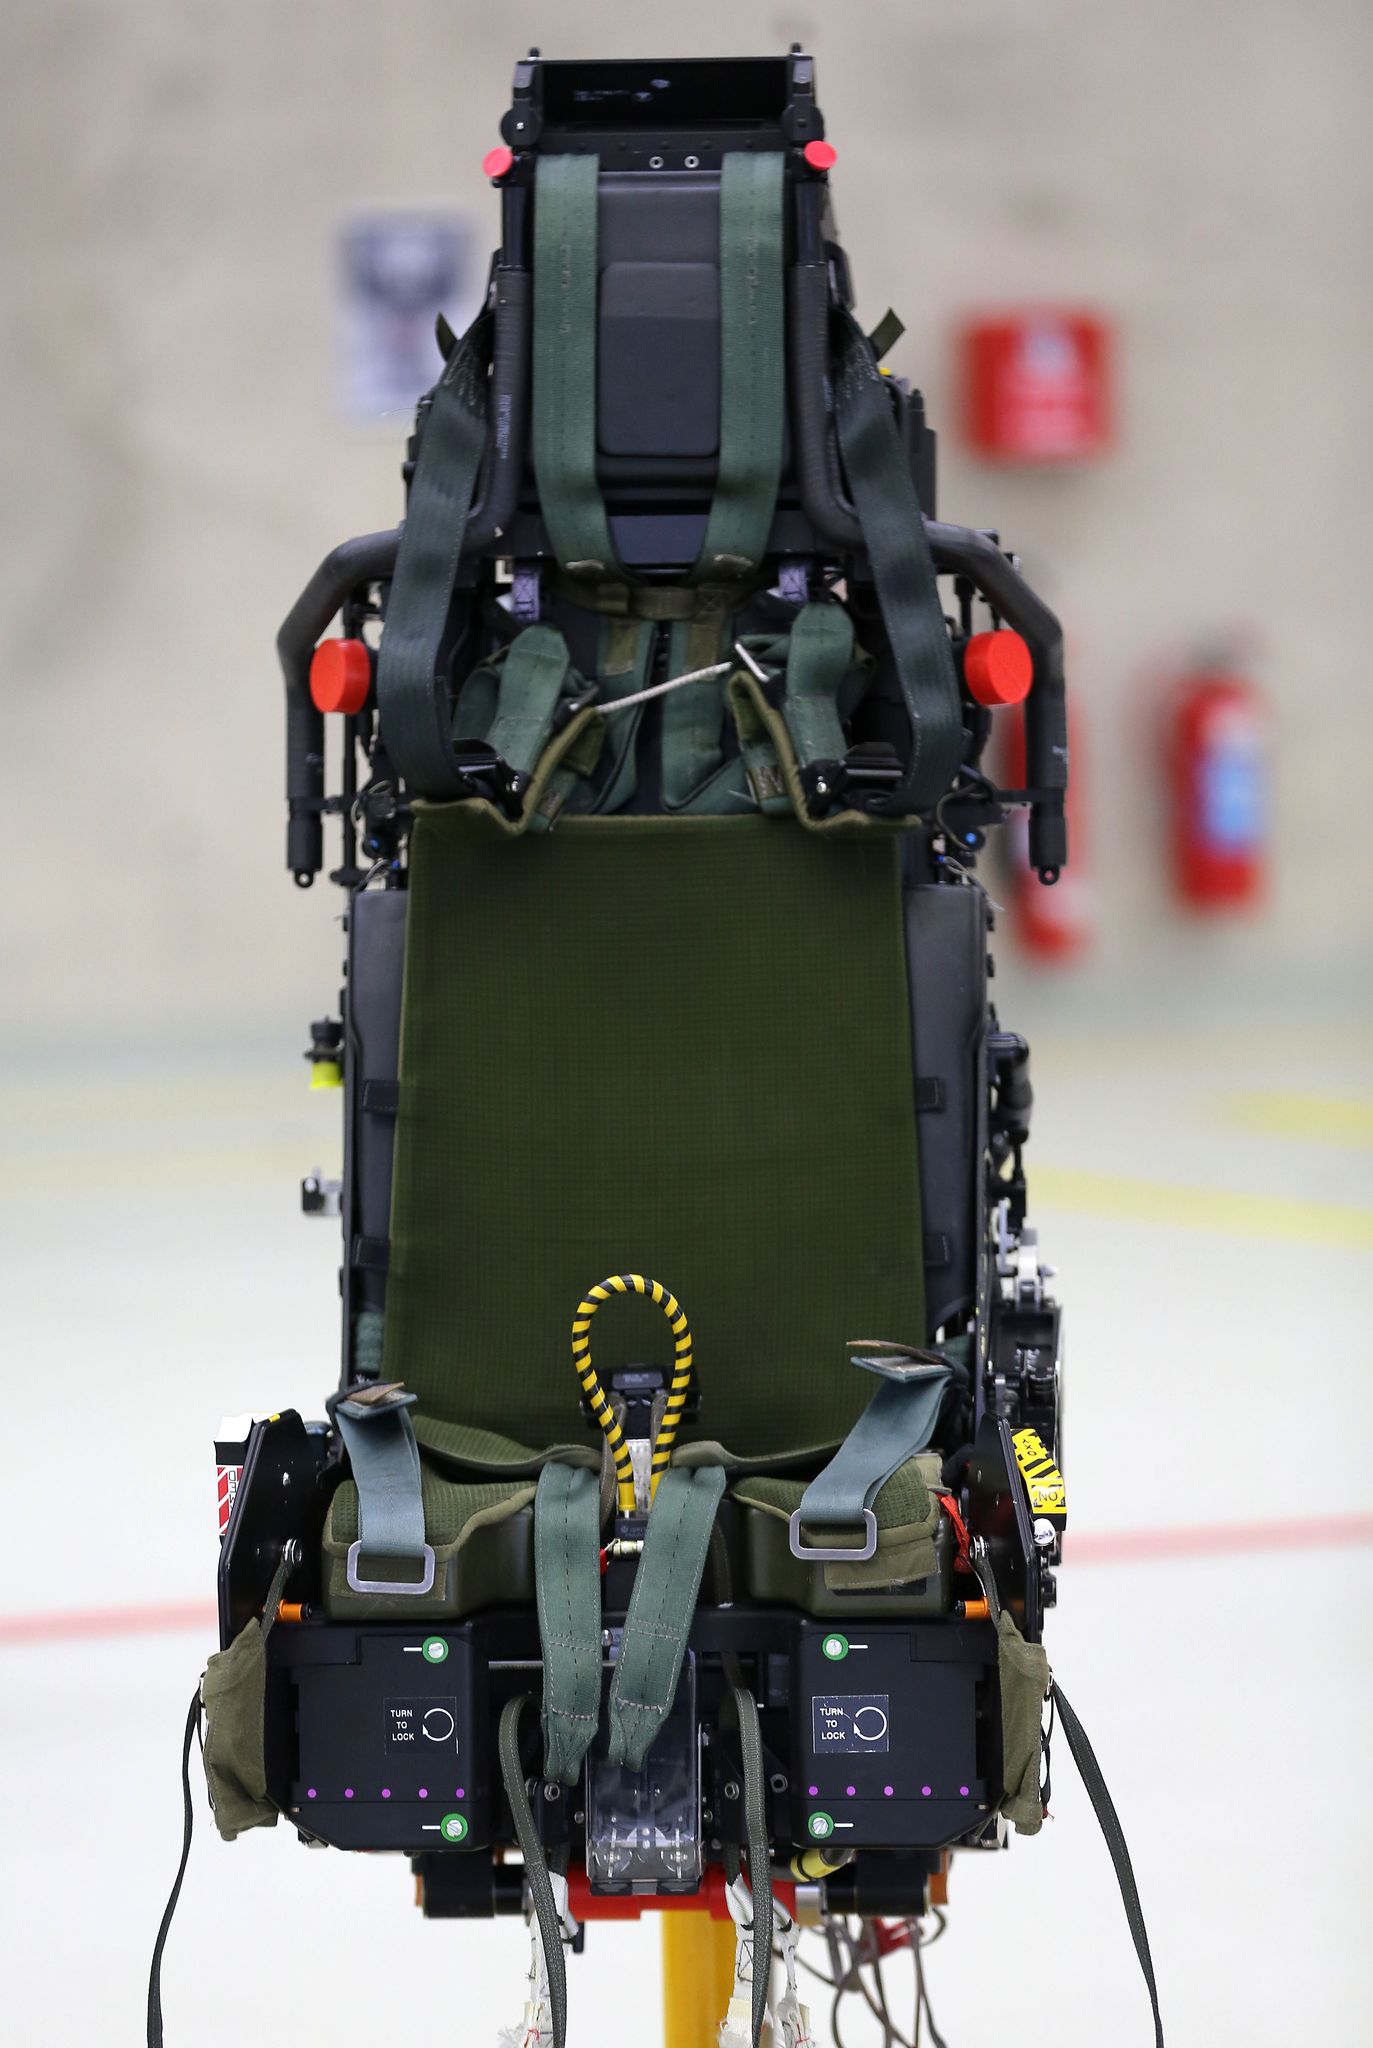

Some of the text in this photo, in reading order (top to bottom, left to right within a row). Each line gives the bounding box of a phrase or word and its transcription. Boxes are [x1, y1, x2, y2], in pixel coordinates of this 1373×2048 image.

[390, 1709, 413, 1718] TURN
[820, 1707, 844, 1716] TURN
[396, 1721, 408, 1729] TO
[825, 1719, 838, 1728] TO
[392, 1733, 415, 1741] LOCK
[821, 1731, 846, 1740] LOCK
